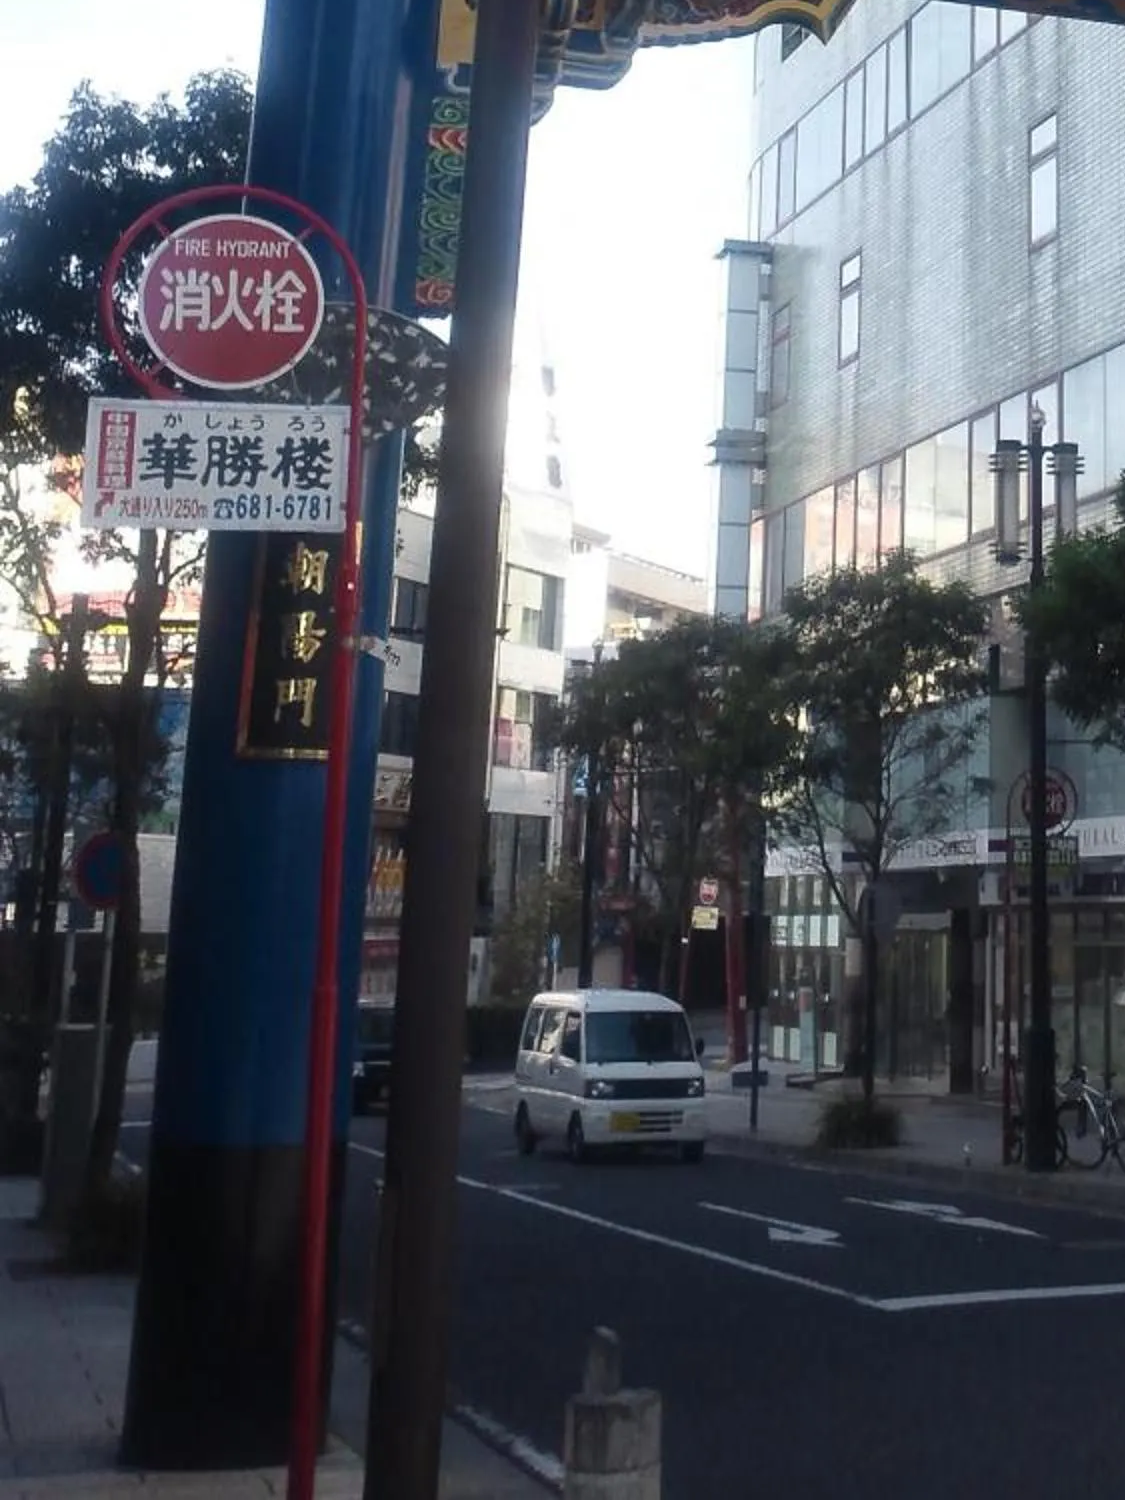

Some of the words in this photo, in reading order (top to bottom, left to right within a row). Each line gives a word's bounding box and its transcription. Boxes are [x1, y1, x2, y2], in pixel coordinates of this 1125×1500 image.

[175, 238, 211, 257] FIRE
[216, 240, 291, 259] HYDRANT
[159, 267, 307, 333] 消火栓
[163, 412, 183, 429] が
[287, 414, 325, 433] ろう
[137, 432, 334, 491] 華勝楼
[236, 494, 331, 521] 681-6781
